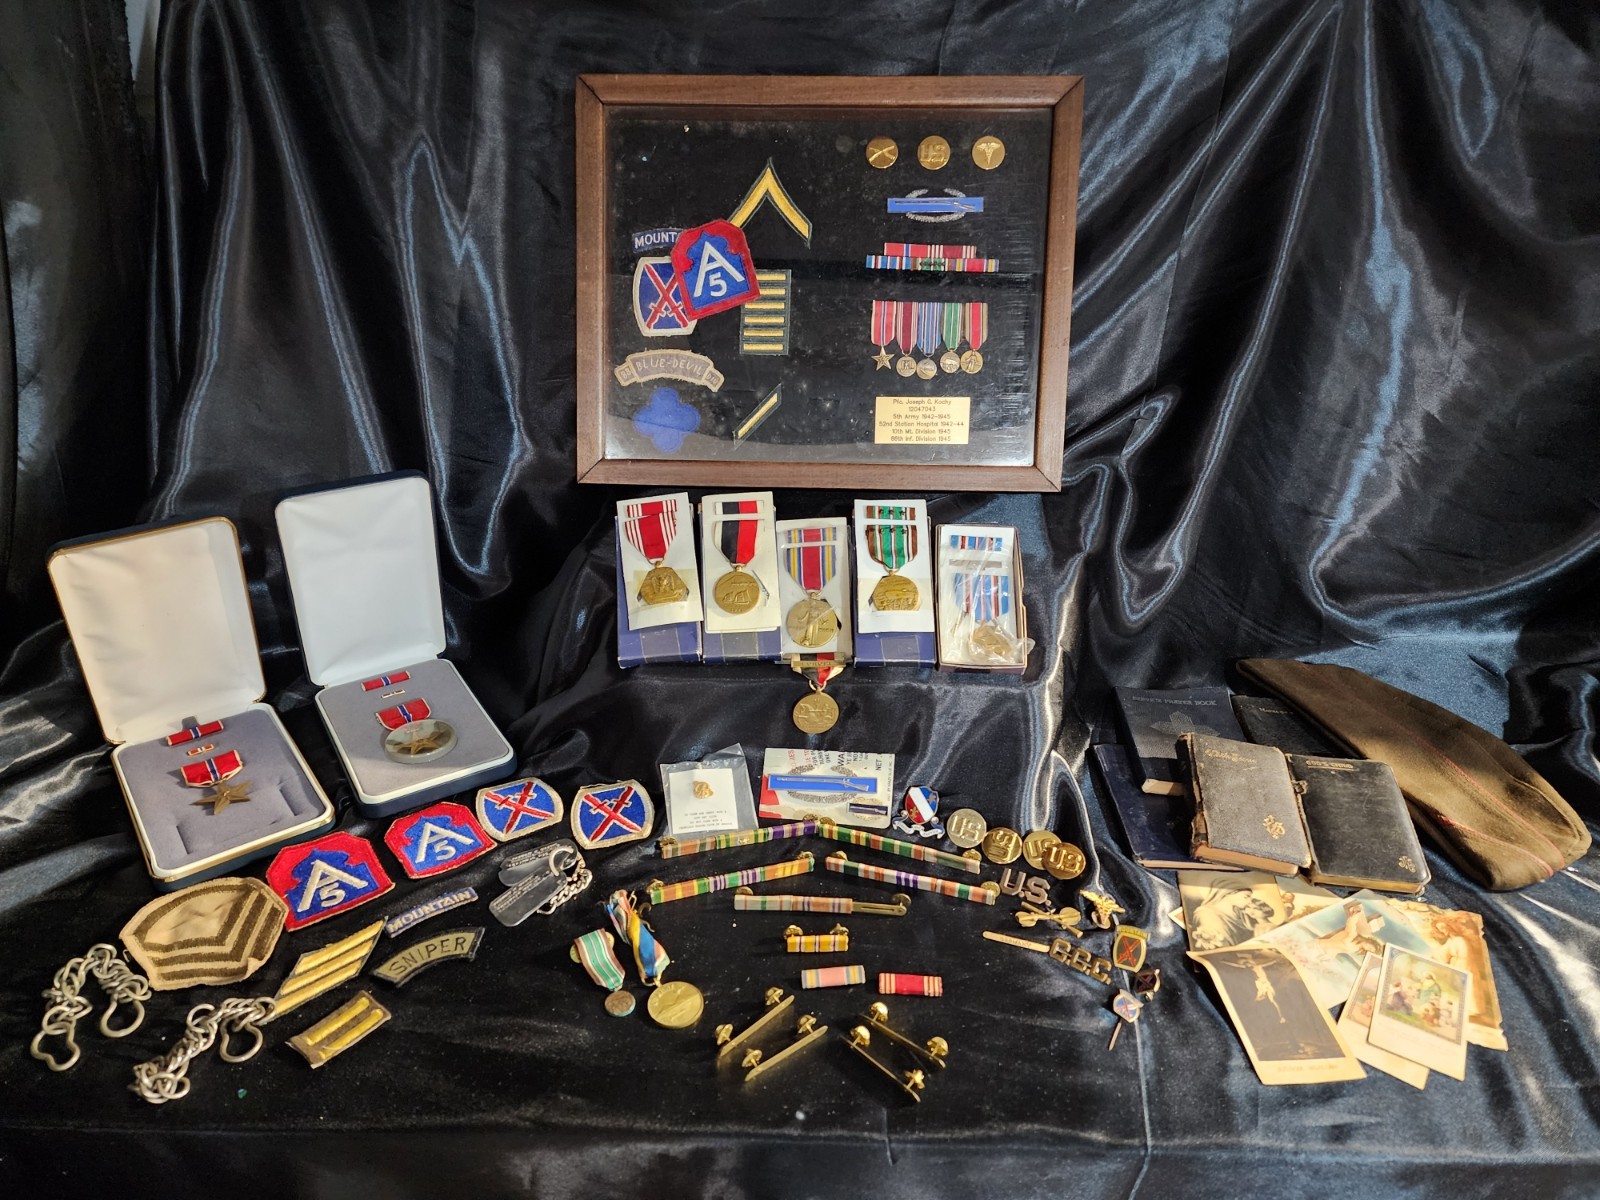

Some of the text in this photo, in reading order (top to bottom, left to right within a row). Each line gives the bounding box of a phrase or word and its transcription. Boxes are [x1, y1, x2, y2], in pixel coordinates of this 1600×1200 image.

[693, 241, 745, 297] A
[708, 271, 727, 297] 5
[905, 413, 919, 421] Army
[917, 420, 939, 428] Hospital
[415, 822, 475, 863] A
[434, 839, 456, 861] 5
[297, 859, 369, 913] A
[318, 882, 346, 908] 5
[387, 890, 473, 934] MOUNTAIN
[389, 936, 468, 974] SNIPER
